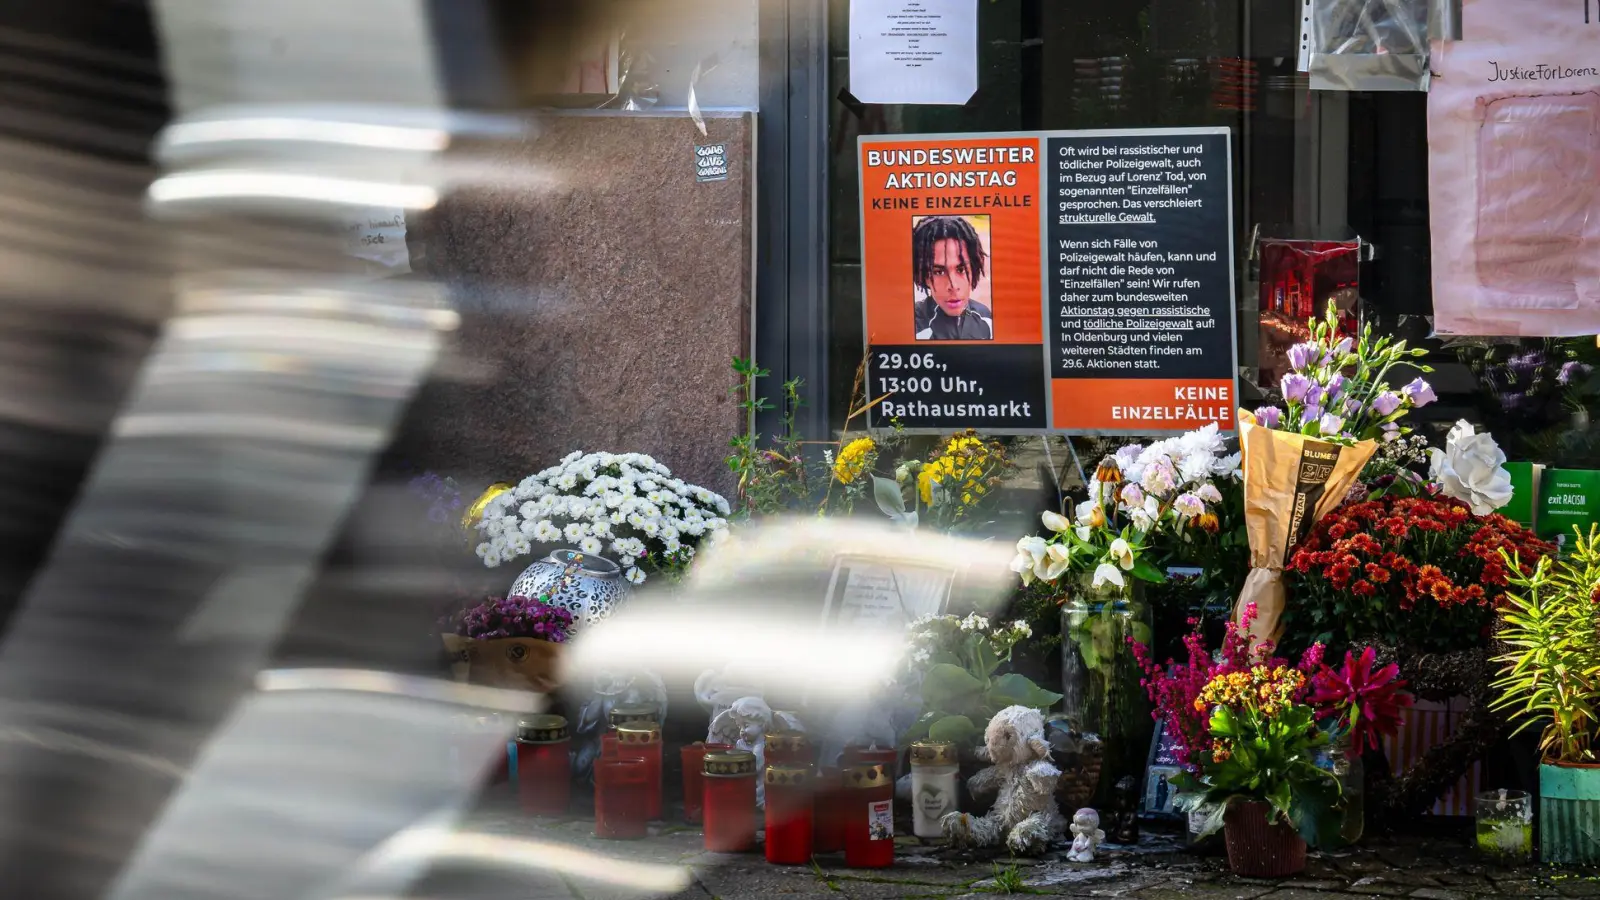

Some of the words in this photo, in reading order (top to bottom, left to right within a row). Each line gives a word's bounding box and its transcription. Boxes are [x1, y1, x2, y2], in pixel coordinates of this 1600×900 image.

[1488, 61, 1599, 82] JusticeForLorenz
[1060, 147, 1075, 156] Oft
[1078, 147, 1099, 156] wird
[1102, 146, 1117, 155] bei
[1120, 145, 1180, 155] rassistischer
[1183, 144, 1203, 154] und
[868, 147, 1035, 167] BUNDESWEITER
[1060, 160, 1102, 169] tödlicher
[1106, 159, 1174, 170] Polizeigewalt,
[1176, 158, 1201, 167] auch
[884, 171, 1017, 189] AKTIONSTAG
[1060, 174, 1072, 183] im
[1076, 174, 1106, 184] Bezug
[1109, 172, 1125, 182] auf
[1165, 172, 1186, 182] Tod,
[1060, 186, 1124, 197] sogenannten
[872, 197, 920, 210] KEINE
[926, 193, 1032, 208] EINZELFÄLLE
[1060, 200, 1120, 210] gesprochen.
[1123, 200, 1141, 209] Das
[1144, 199, 1202, 208] verschleiert
[1059, 213, 1116, 224] strukturelle
[1119, 212, 1156, 223] Gewalt.
[1060, 240, 1088, 249] Wenn
[1091, 240, 1110, 248] sich
[1114, 239, 1136, 248] Fälle
[1139, 240, 1157, 248] von
[1060, 253, 1125, 264] Polizeigewalt
[1128, 252, 1166, 262] häufen,
[1168, 252, 1193, 261] kann
[1196, 252, 1216, 261] und
[1060, 266, 1080, 275] darf
[1082, 266, 1107, 275] nicht
[1110, 266, 1125, 275] die
[1128, 266, 1154, 275] Rede
[1127, 279, 1150, 288] sein!
[1152, 279, 1170, 288] Wir
[1173, 279, 1200, 288] rufen
[1060, 293, 1089, 302] daher
[1116, 292, 1188, 301] bundesweiten
[1061, 306, 1114, 316] Aktionstag
[1117, 308, 1149, 316] gegen
[1152, 305, 1210, 316] rassistische
[1061, 319, 1081, 328] und
[1083, 319, 1123, 330] tödliche
[1126, 319, 1194, 330] Polizeigewalt
[1196, 319, 1215, 328] auf!
[1062, 333, 1071, 341] In
[1074, 333, 1127, 343] Oldenburg
[1130, 332, 1150, 341] und
[1152, 332, 1182, 341] vielen
[1062, 346, 1105, 355] weiteren
[1108, 346, 1147, 355] Städten
[1149, 346, 1183, 355] finden
[878, 354, 947, 372] 29.06.,
[1063, 360, 1084, 368] 29.6.
[1087, 359, 1131, 368] Aktionen
[1134, 359, 1160, 368] statt.
[879, 377, 932, 394] 13:00
[940, 377, 984, 395] Uhr,
[1174, 386, 1228, 400] KEINE
[881, 401, 1031, 417] Rathausmarkt
[1112, 404, 1229, 420] EINZELFÄLLE
[1548, 494, 1562, 504] exit
[1563, 494, 1585, 505] RACISM
